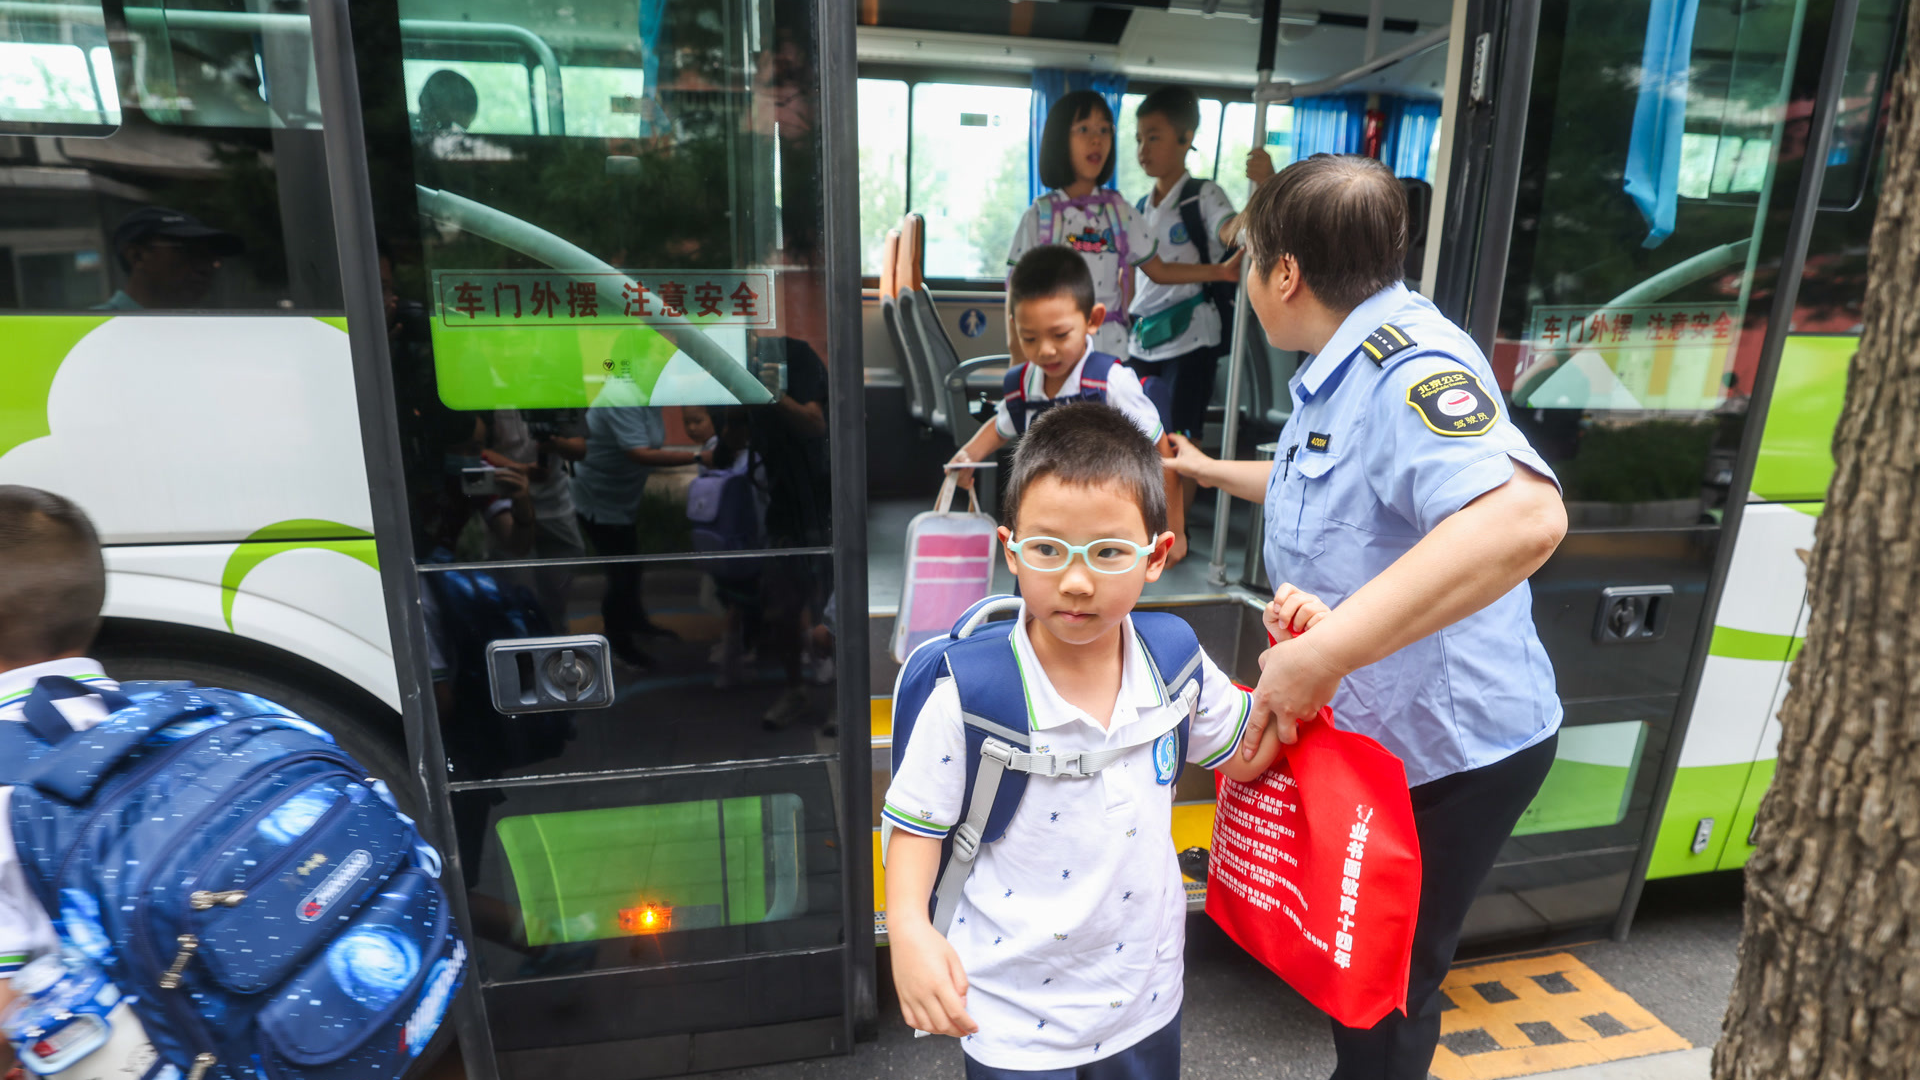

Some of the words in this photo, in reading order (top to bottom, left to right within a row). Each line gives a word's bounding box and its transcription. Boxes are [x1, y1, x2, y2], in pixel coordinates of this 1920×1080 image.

[454, 281, 599, 319] 车门外摆
[622, 280, 759, 318] 注意安全
[1541, 313, 1633, 344] 车门外摆
[1646, 311, 1733, 341] 注意安全
[1417, 373, 1466, 394] 北京公交
[1453, 412, 1489, 429] 驾驶员
